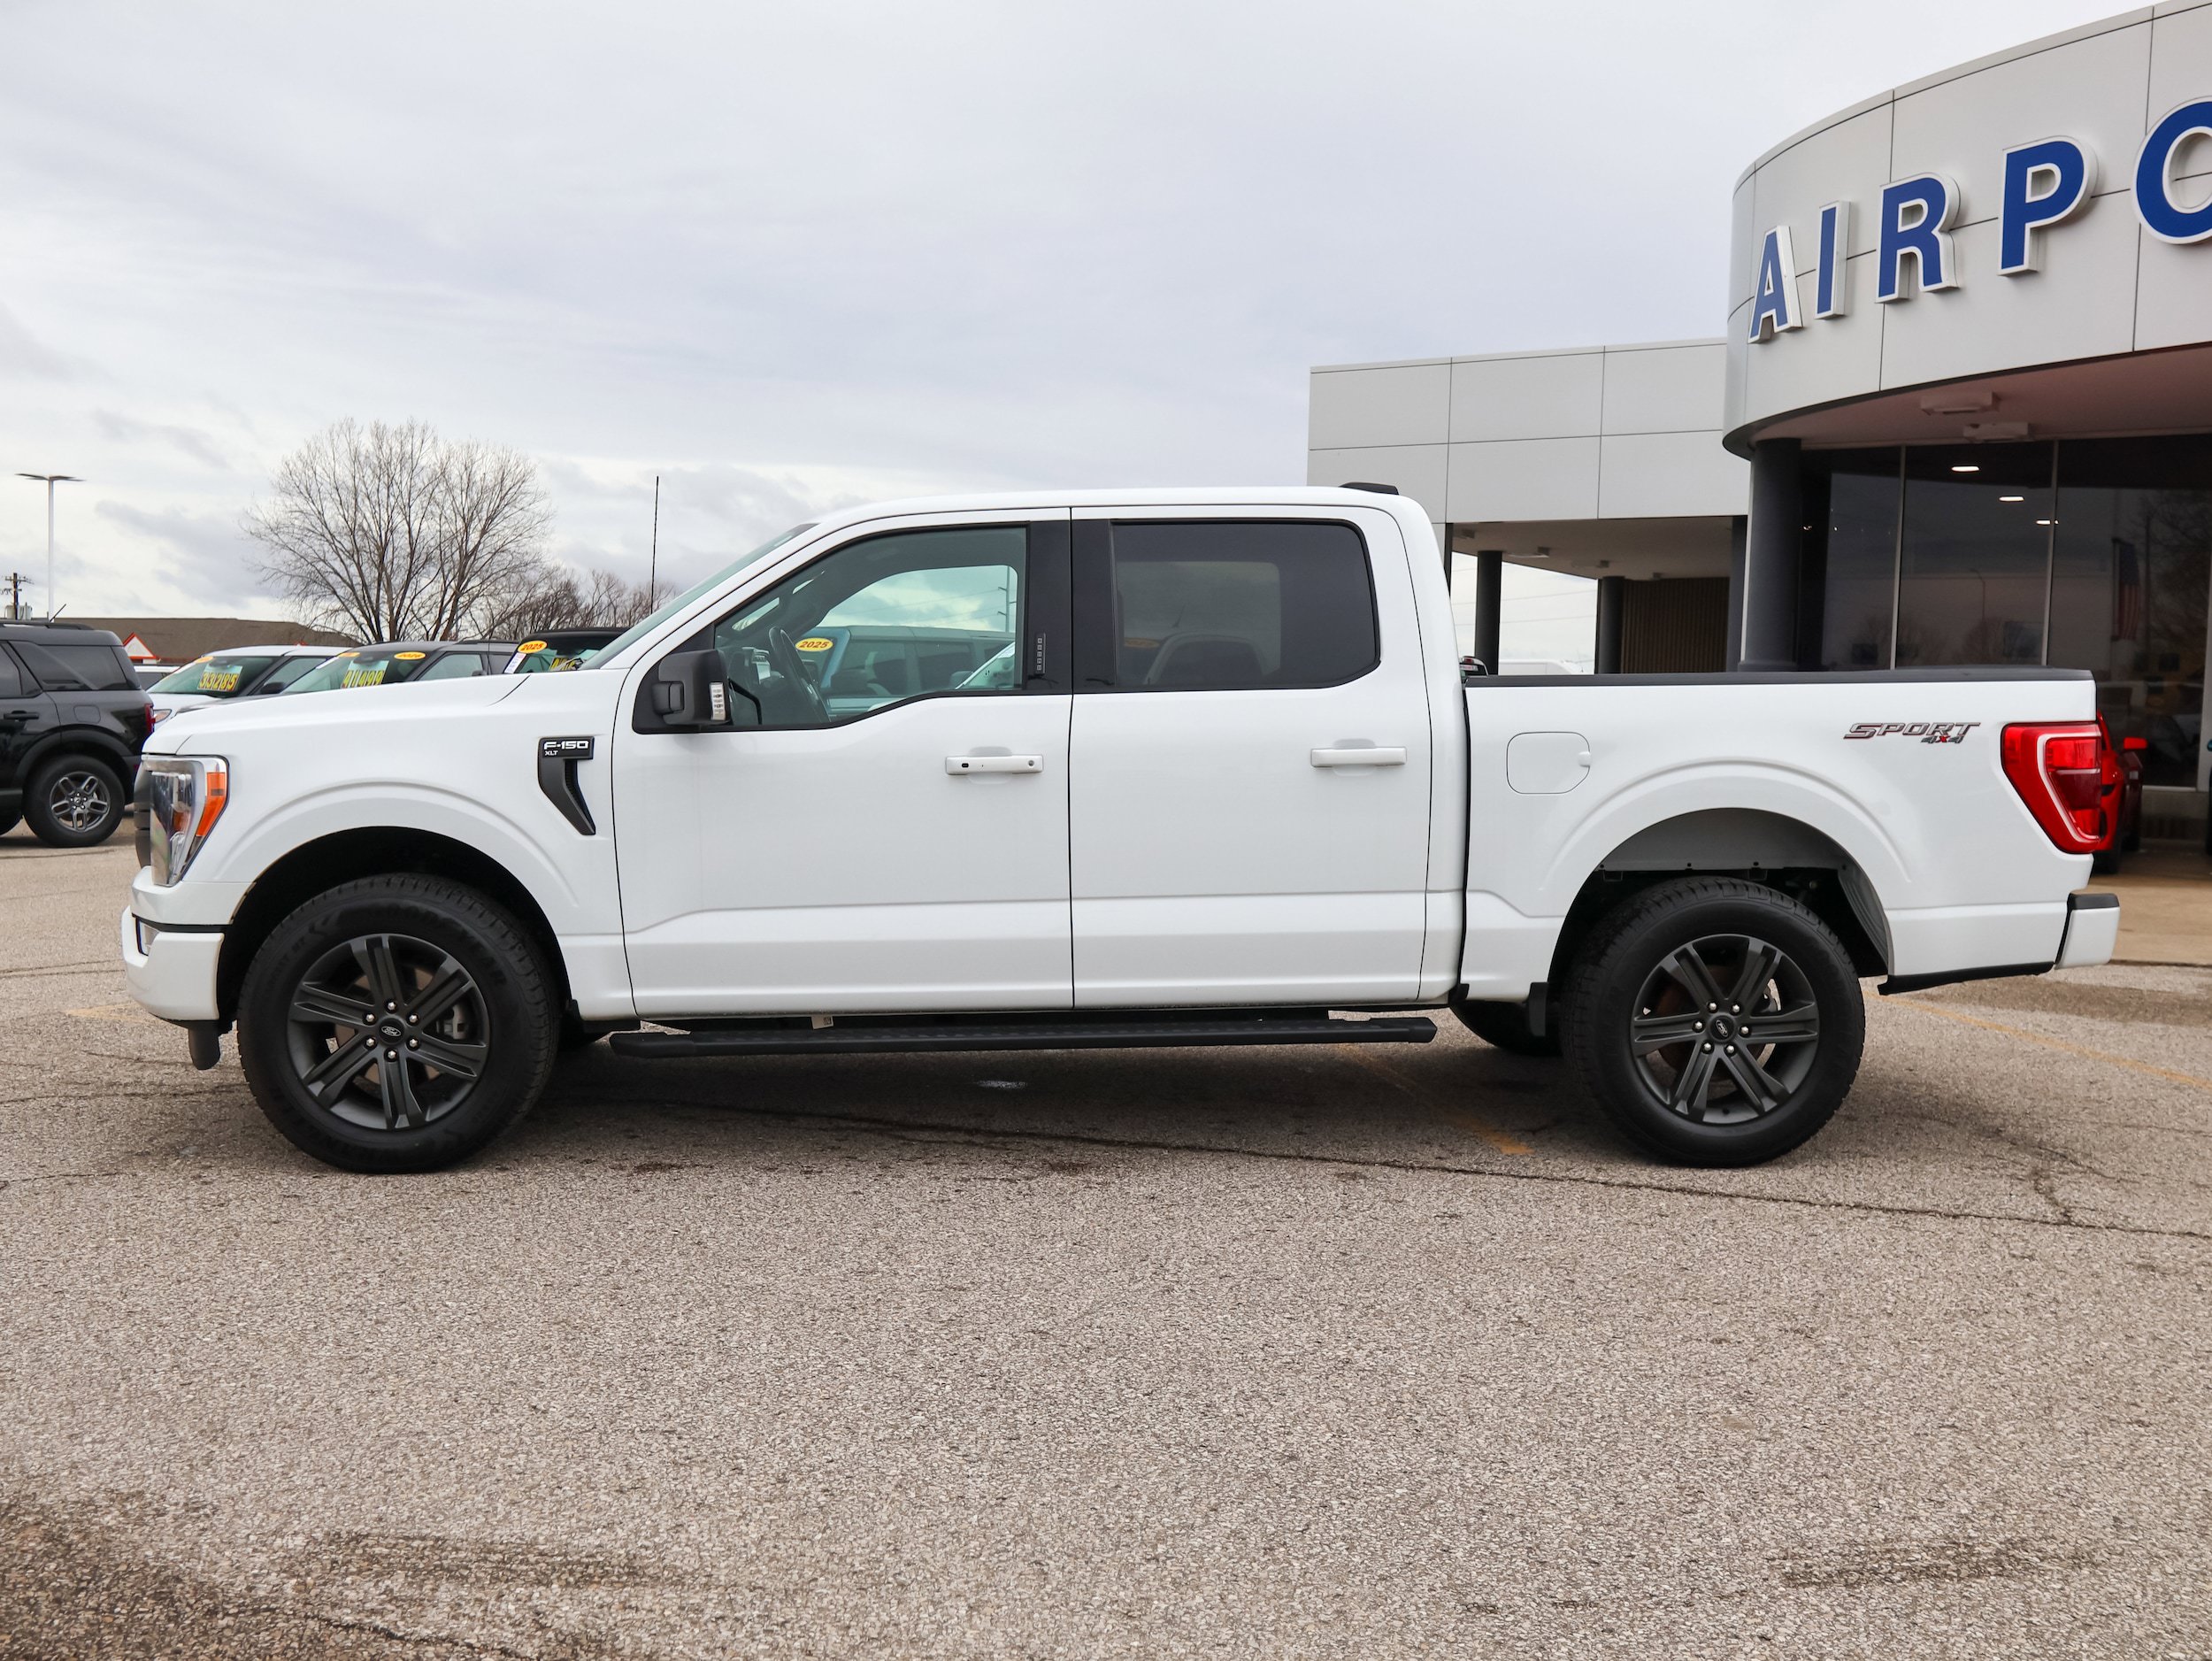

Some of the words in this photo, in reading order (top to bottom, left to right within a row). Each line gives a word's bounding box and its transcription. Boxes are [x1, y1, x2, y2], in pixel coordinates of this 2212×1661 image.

[519, 642, 544, 652] 2025
[1843, 721, 1982, 740] SPORT
[543, 740, 589, 750] F-150
